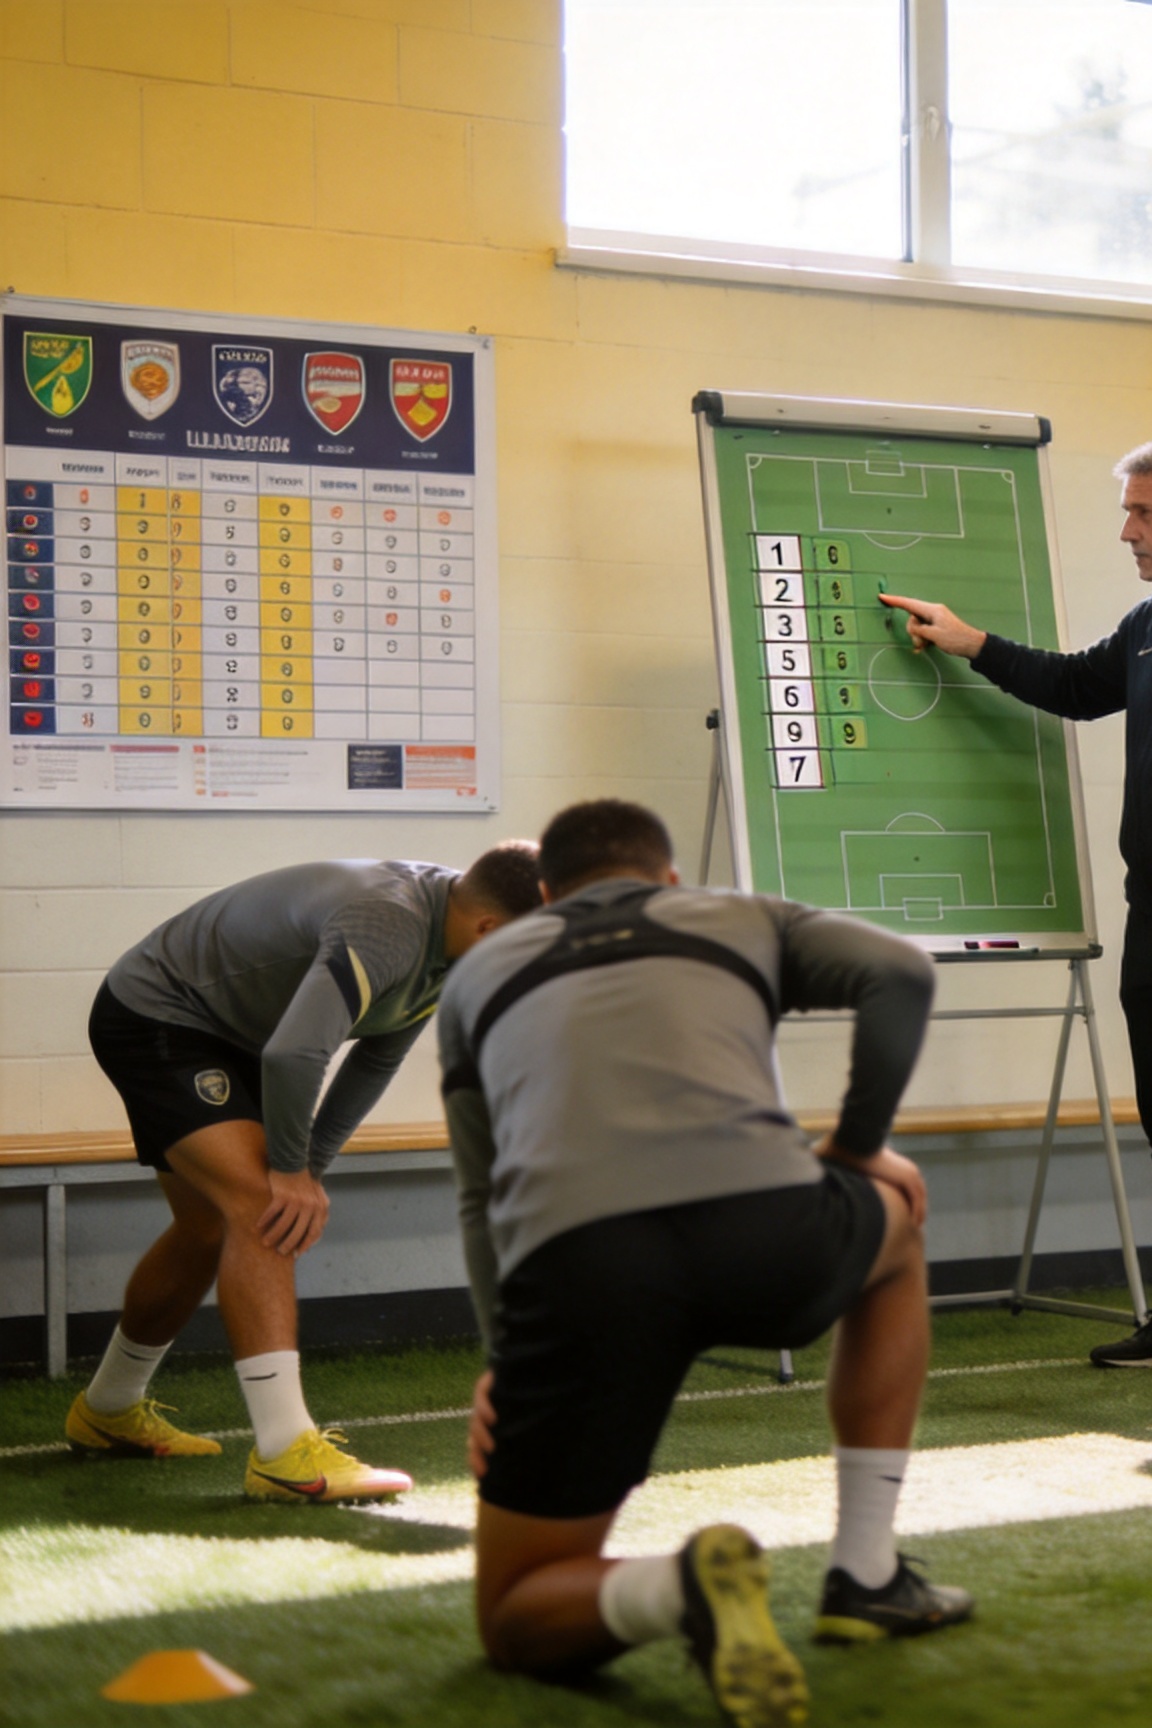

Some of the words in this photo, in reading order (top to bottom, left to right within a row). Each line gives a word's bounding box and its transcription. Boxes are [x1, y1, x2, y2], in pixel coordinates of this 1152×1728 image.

[771, 542, 783, 566] 1
[774, 578, 793, 602] 2
[777, 614, 793, 637] 3
[781, 650, 797, 672] 5
[784, 685, 800, 708] 6
[787, 721, 803, 743] 9
[789, 755, 807, 783] 7
